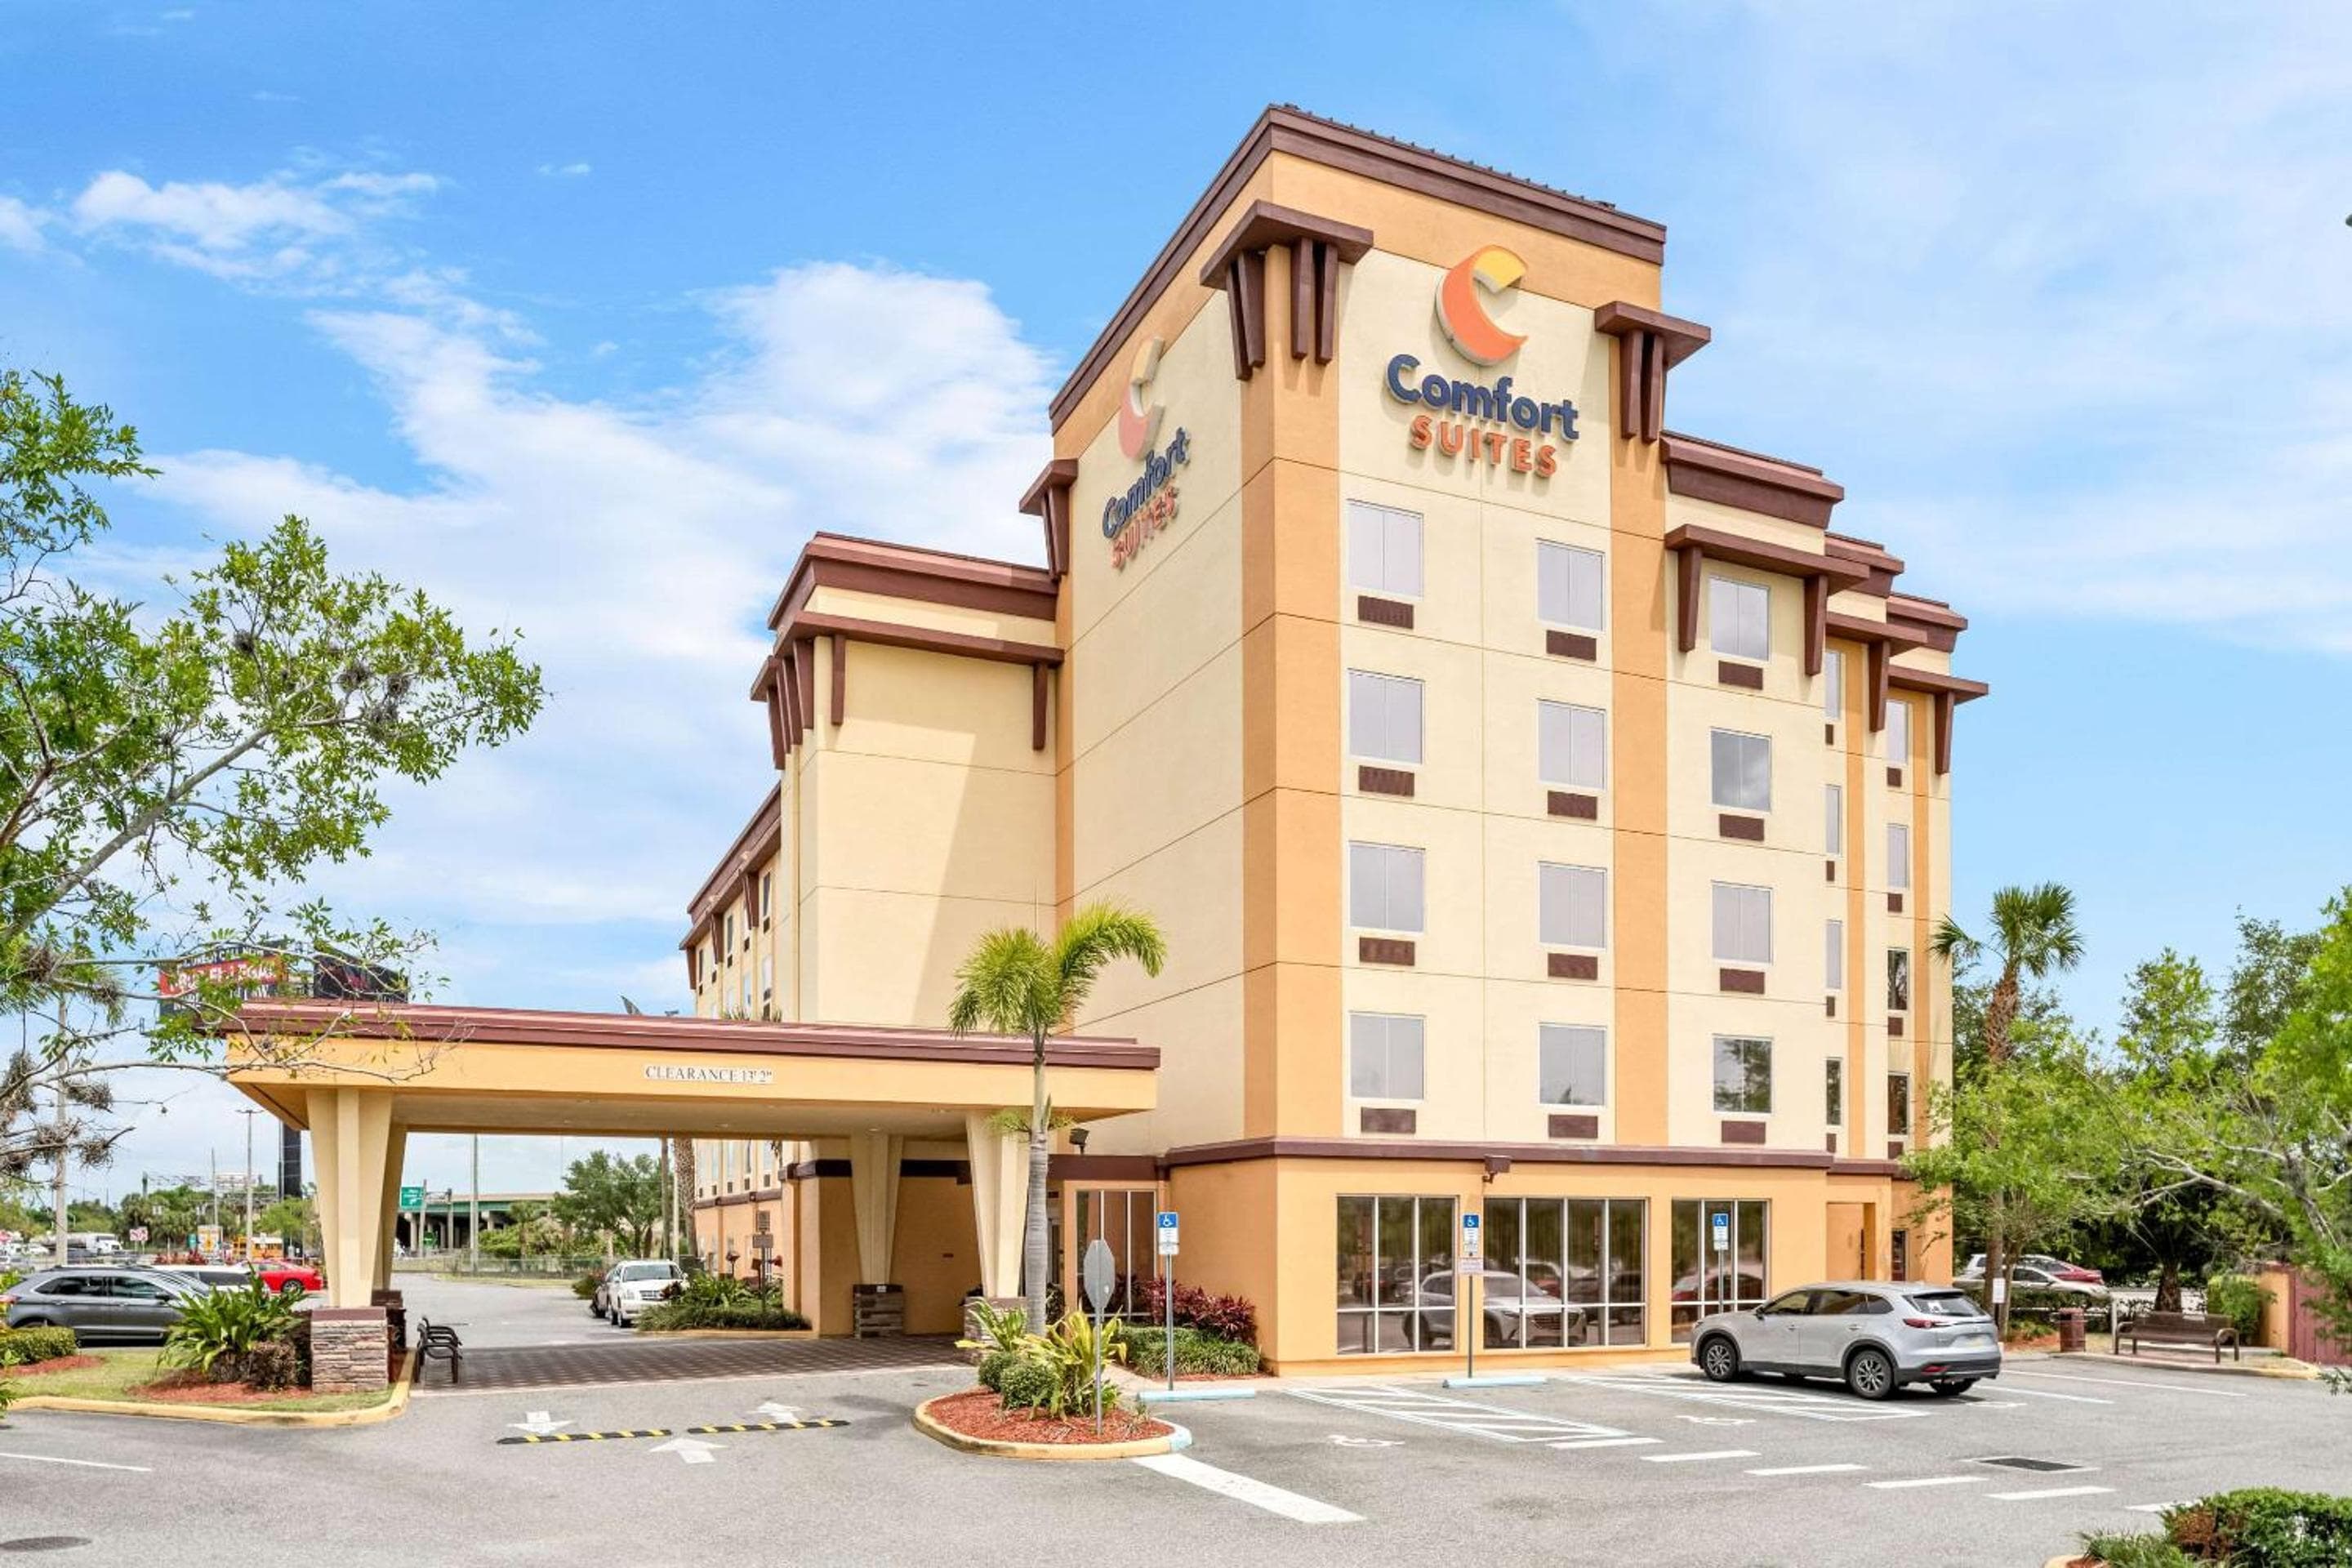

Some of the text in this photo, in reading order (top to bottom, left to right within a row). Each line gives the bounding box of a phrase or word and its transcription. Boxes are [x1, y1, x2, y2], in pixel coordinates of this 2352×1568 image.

[1386, 353, 1580, 443] Comfort
[1102, 426, 1190, 538] Comfort
[1410, 414, 1557, 479] SUITES
[1111, 485, 1177, 569] SUITES
[645, 1065, 737, 1082] CLEARANCE
